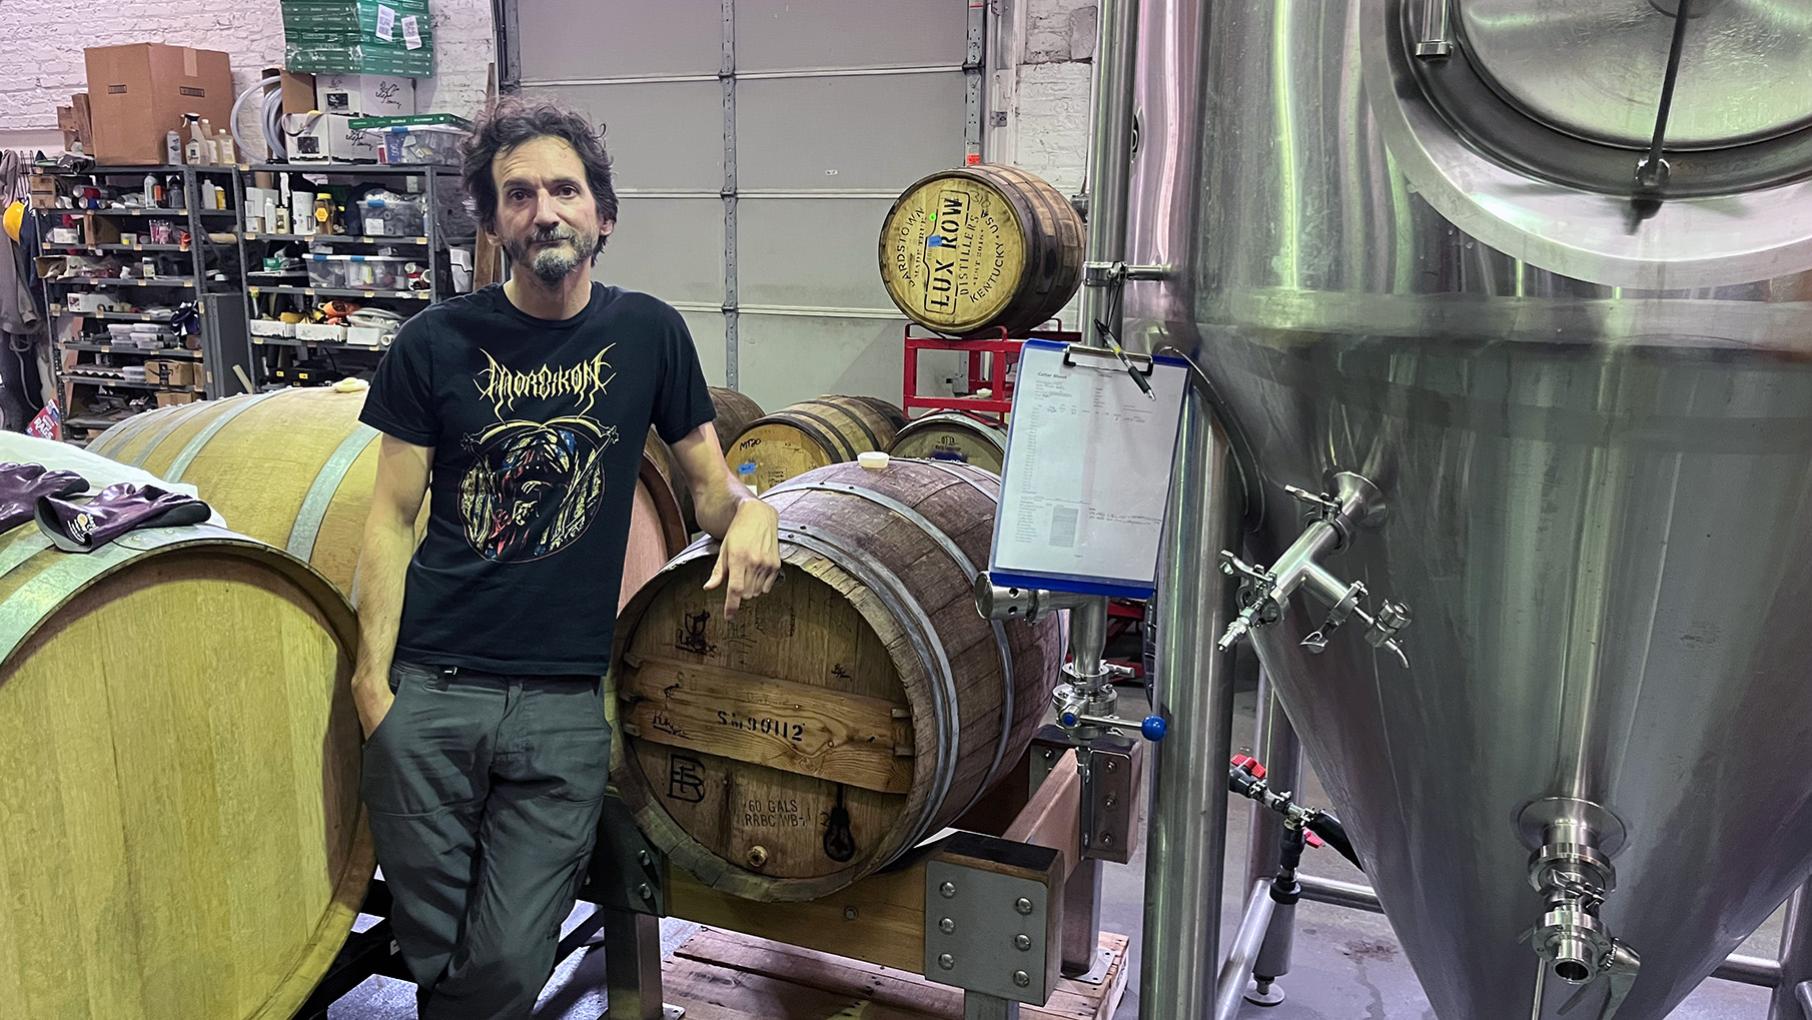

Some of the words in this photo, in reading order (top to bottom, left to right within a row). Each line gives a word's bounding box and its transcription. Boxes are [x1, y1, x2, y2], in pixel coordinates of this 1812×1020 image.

[940, 197, 963, 250] ROW
[981, 209, 999, 235] USA
[959, 215, 980, 296] DISTILLERS
[970, 242, 1005, 303] KENTUCKY
[931, 260, 955, 307] LUX
[744, 813, 776, 828] RRBC
[748, 799, 762, 813] 60
[768, 799, 798, 813] GALS
